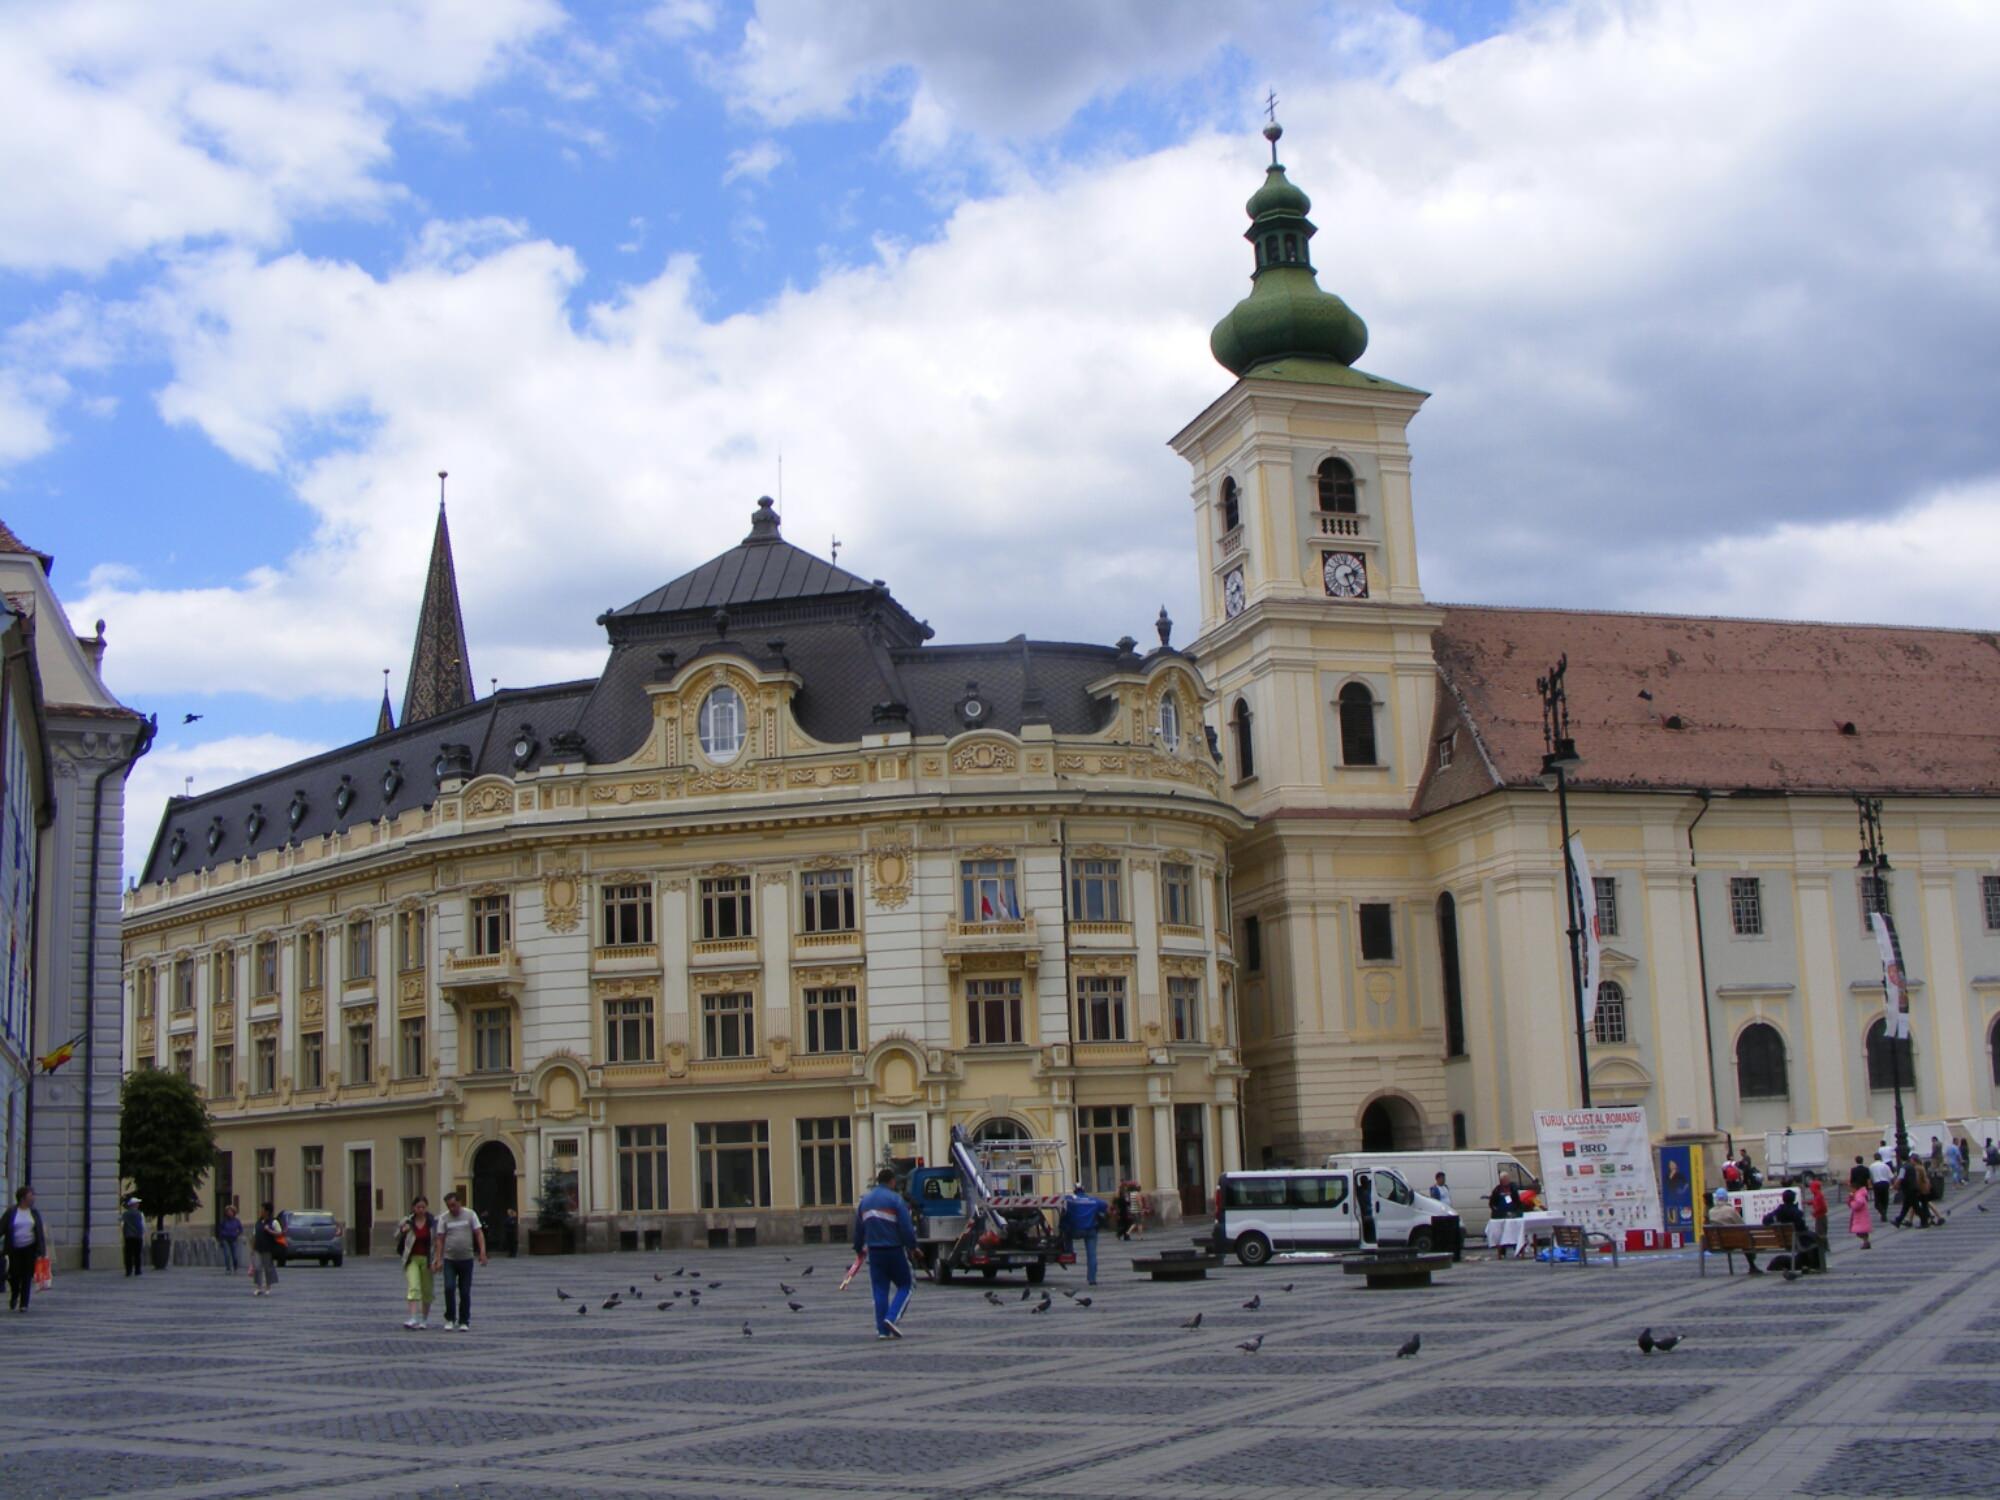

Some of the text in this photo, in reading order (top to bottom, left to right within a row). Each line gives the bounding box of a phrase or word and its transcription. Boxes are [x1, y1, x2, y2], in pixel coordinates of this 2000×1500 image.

[1540, 1115, 1566, 1127] TURUL
[1567, 1113, 1594, 1125] CICLIST
[1594, 1113, 1604, 1124] AL
